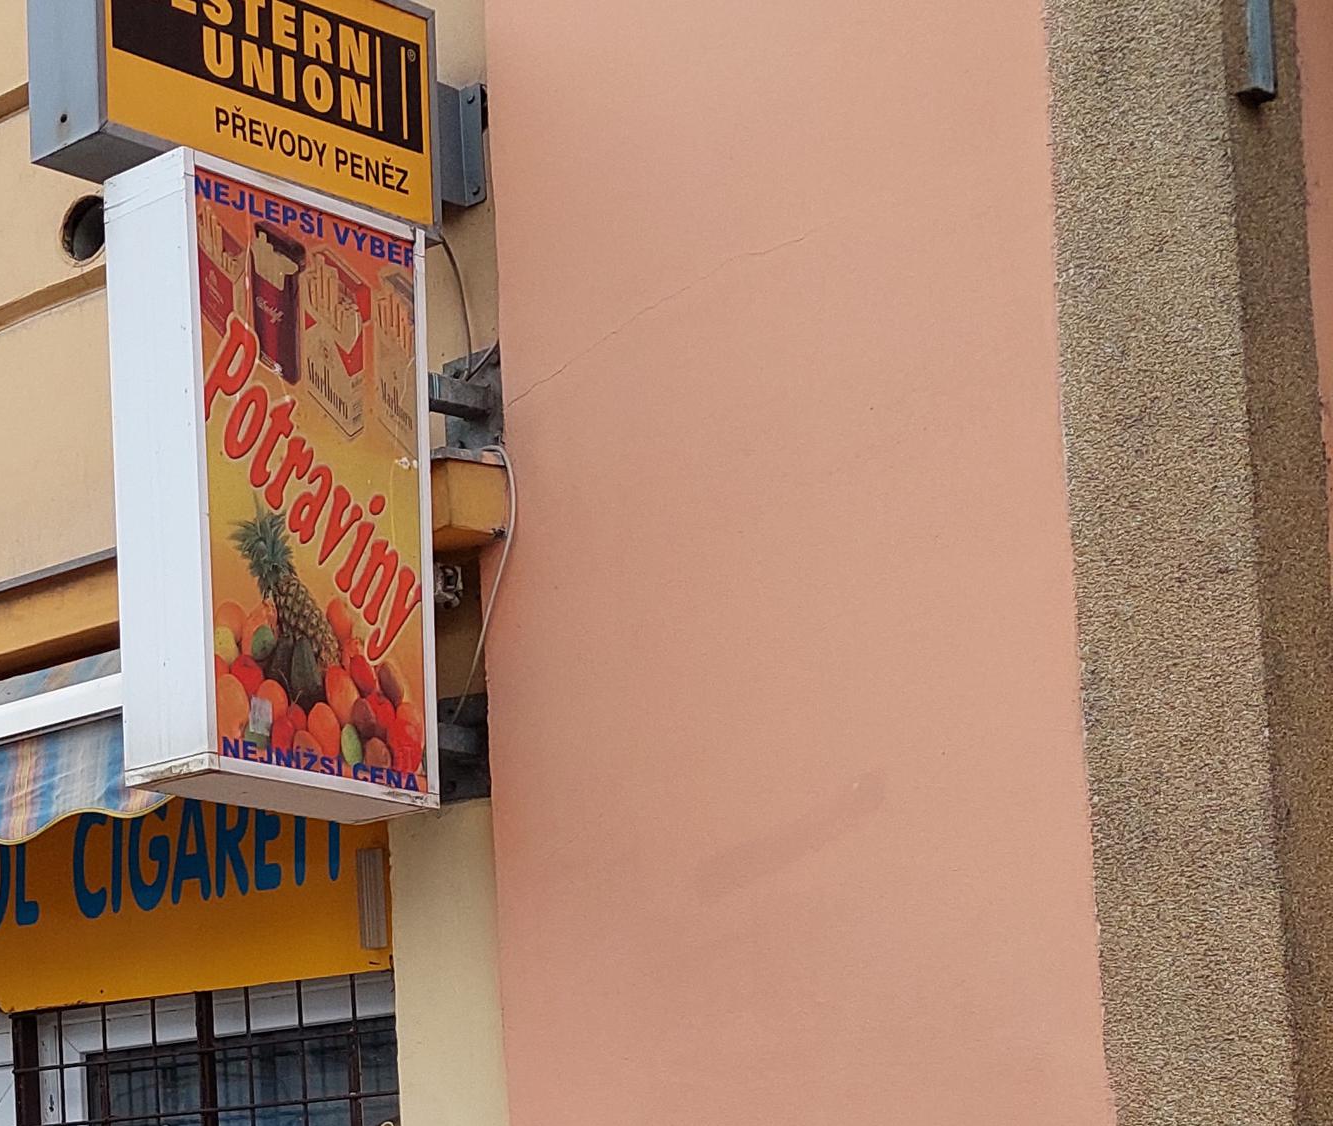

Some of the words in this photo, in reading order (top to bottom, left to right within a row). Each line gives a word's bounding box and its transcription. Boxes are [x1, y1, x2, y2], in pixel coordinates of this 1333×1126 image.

[171, 0, 371, 77] STERN
[203, 27, 373, 130] UNION
[215, 105, 328, 167] PŘEVODY
[334, 149, 410, 196] PENĚZ
[195, 174, 323, 238] NEJLEPŠÍ
[204, 318, 422, 661] Potraviny
[352, 762, 420, 792] CENA
